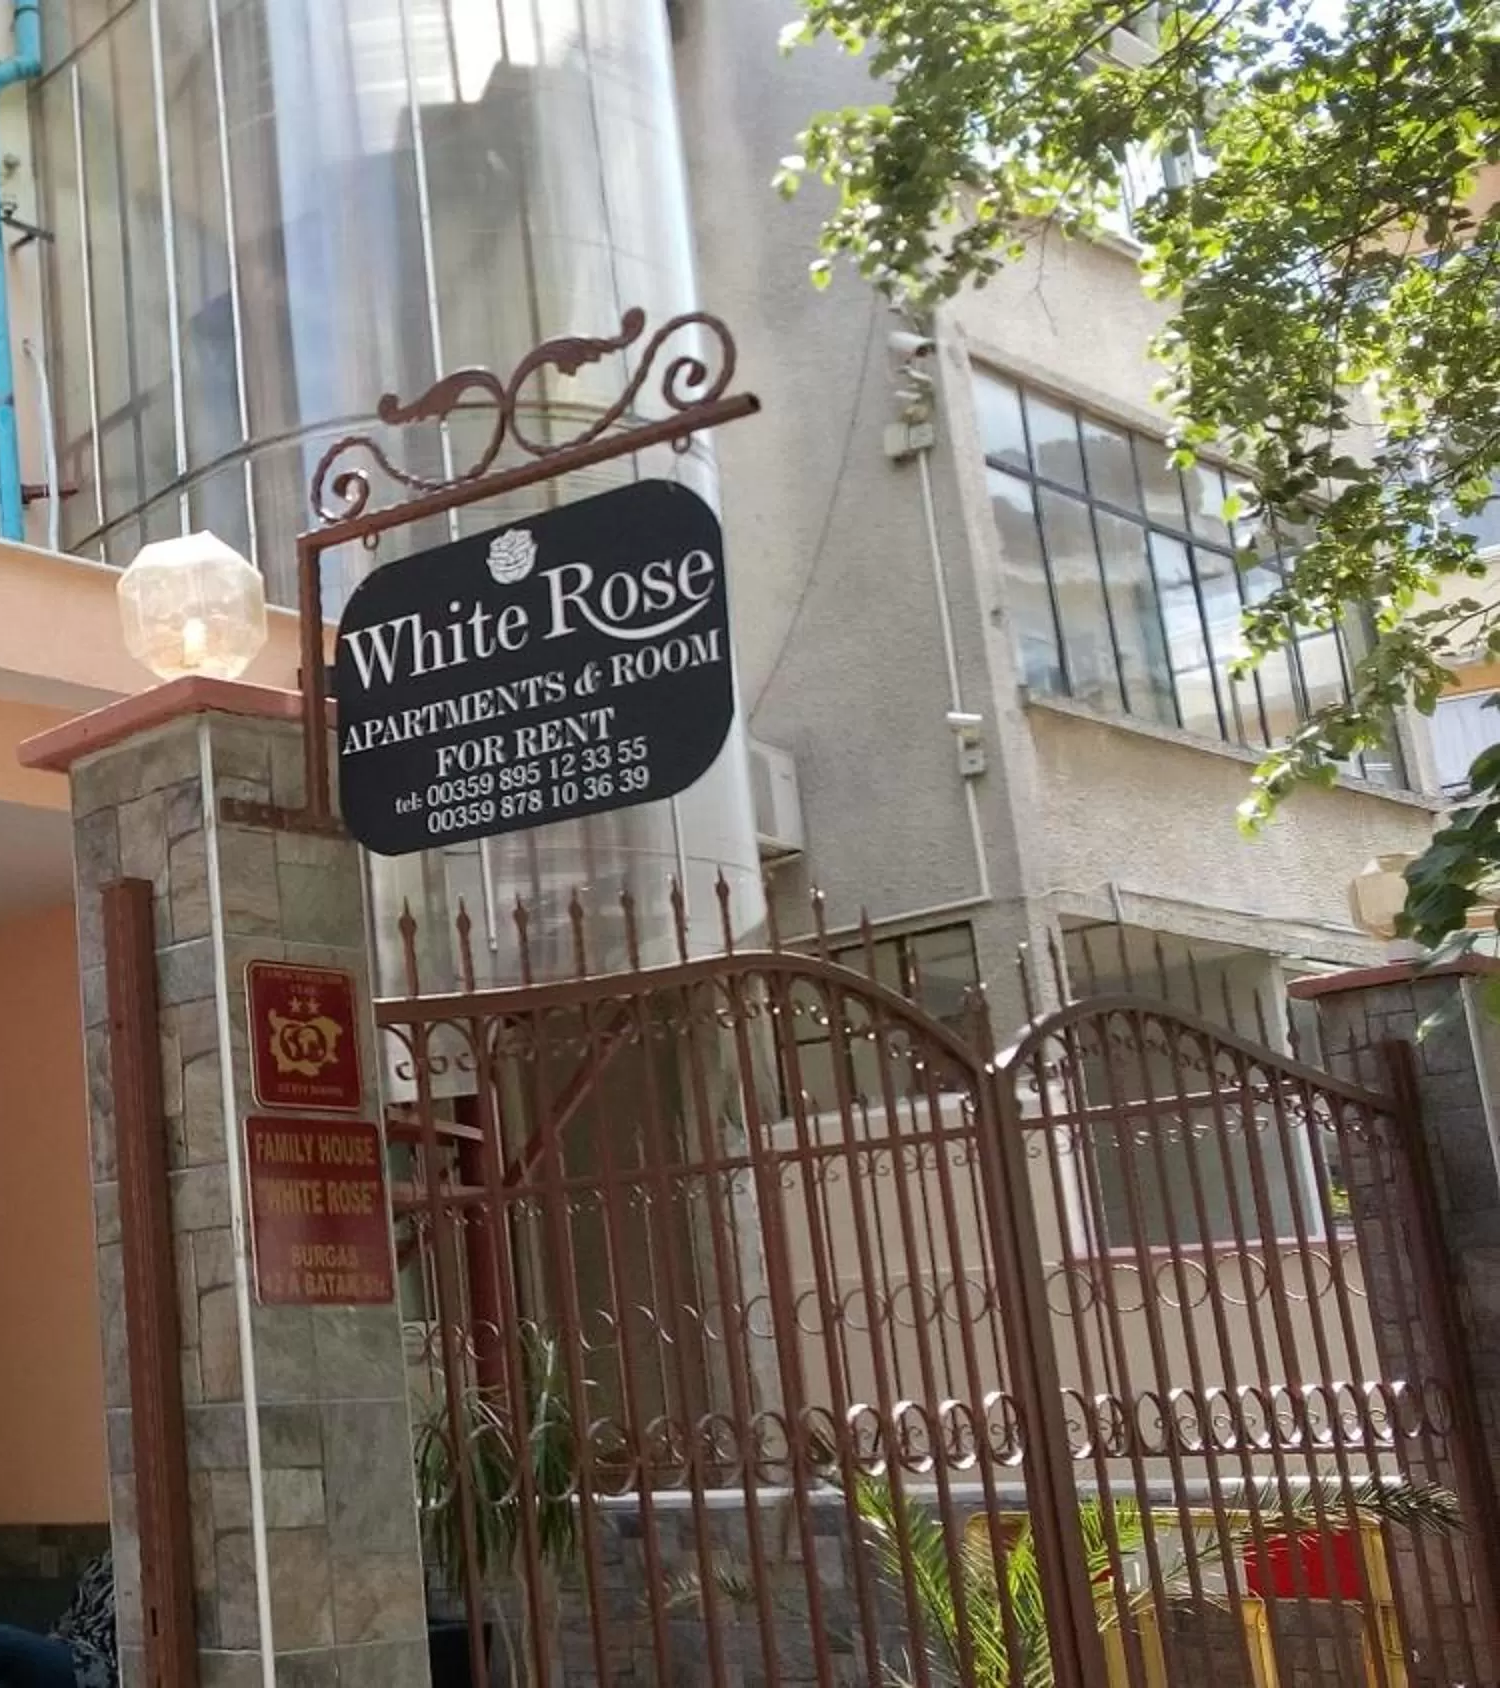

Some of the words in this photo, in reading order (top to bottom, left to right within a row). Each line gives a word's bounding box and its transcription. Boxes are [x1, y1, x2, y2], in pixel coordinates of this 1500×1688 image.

[340, 600, 530, 691] White
[539, 549, 716, 641] Rose
[342, 671, 567, 756] APARTMENTS
[573, 660, 601, 697] &
[610, 629, 724, 689] ROOM
[426, 772, 495, 807] 00359
[499, 761, 542, 791] 895
[550, 753, 577, 779] 12
[581, 745, 612, 772] 33
[617, 736, 648, 764] 55
[436, 735, 506, 778] FOR
[514, 707, 616, 759] RENT
[427, 800, 496, 834] 00359
[500, 789, 543, 818] 878
[551, 782, 578, 807] 10
[583, 774, 614, 800] 36
[619, 765, 650, 793] 39
[254, 1132, 314, 1164] FAMILY
[318, 1135, 376, 1166] HOUSE
[291, 1244, 359, 1268] BURGAS
